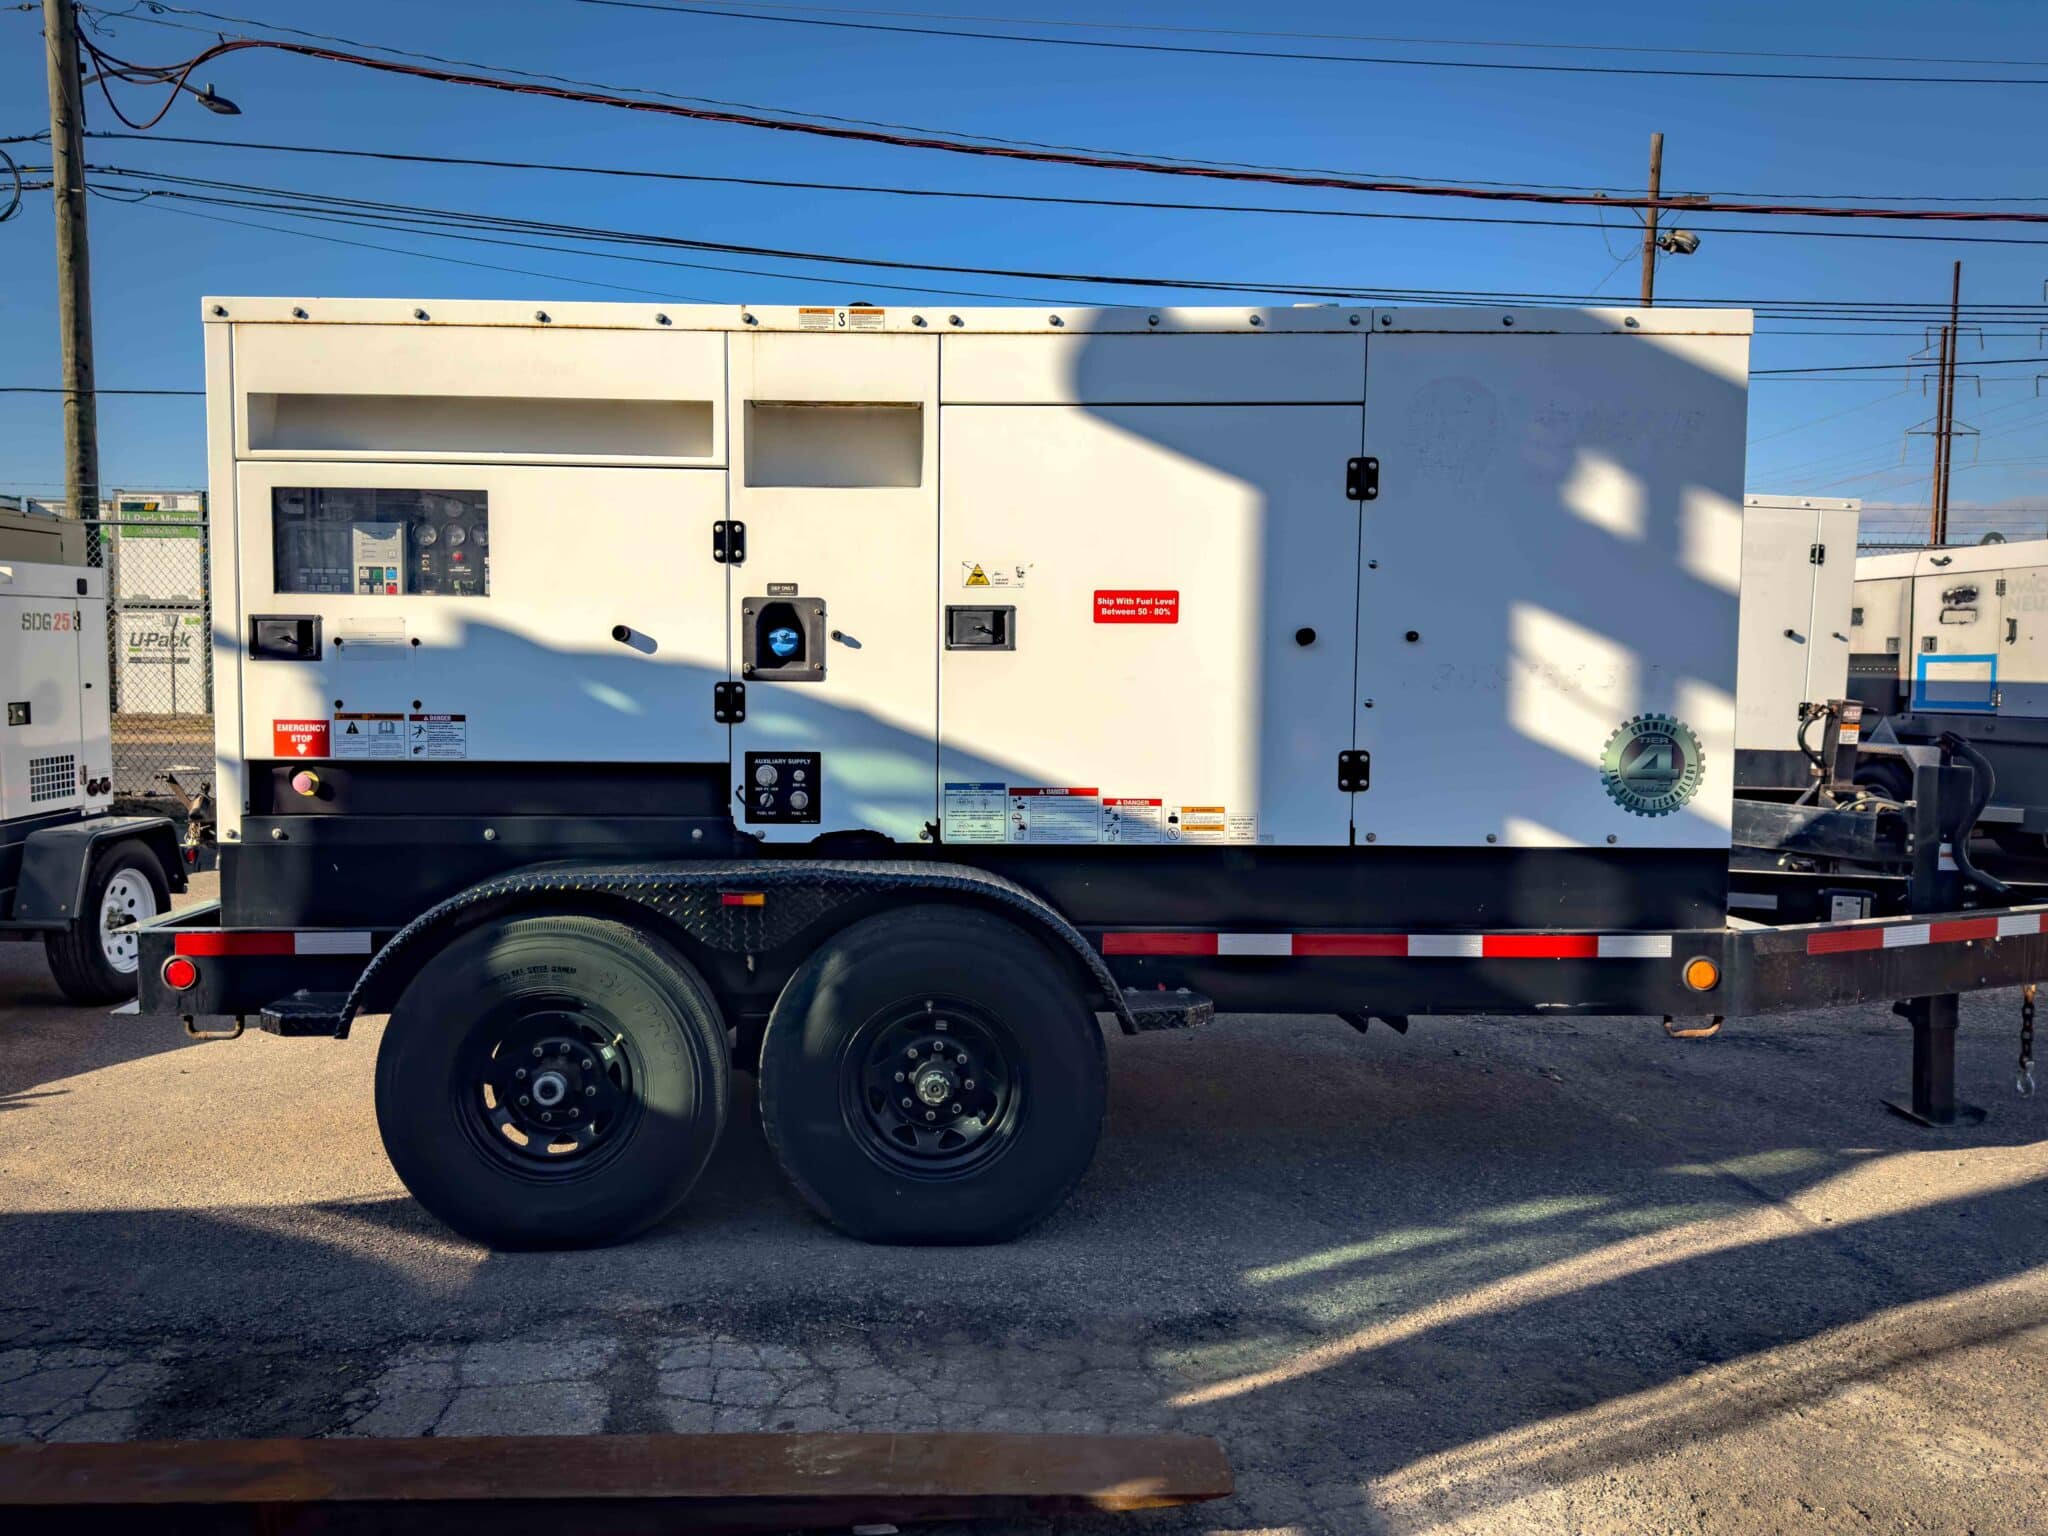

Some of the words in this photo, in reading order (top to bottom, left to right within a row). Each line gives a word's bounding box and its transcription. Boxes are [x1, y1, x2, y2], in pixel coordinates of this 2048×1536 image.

[1097, 598, 1114, 606] Ship
[276, 724, 327, 732] EMERGENCY
[290, 735, 313, 743] STOP
[1638, 736, 1670, 745] TIER
[1627, 744, 1680, 785] 4
[1608, 768, 1622, 786] THE
[1619, 787, 1646, 808] RIGHT
[1652, 763, 1697, 808] TECHNOLOGY
